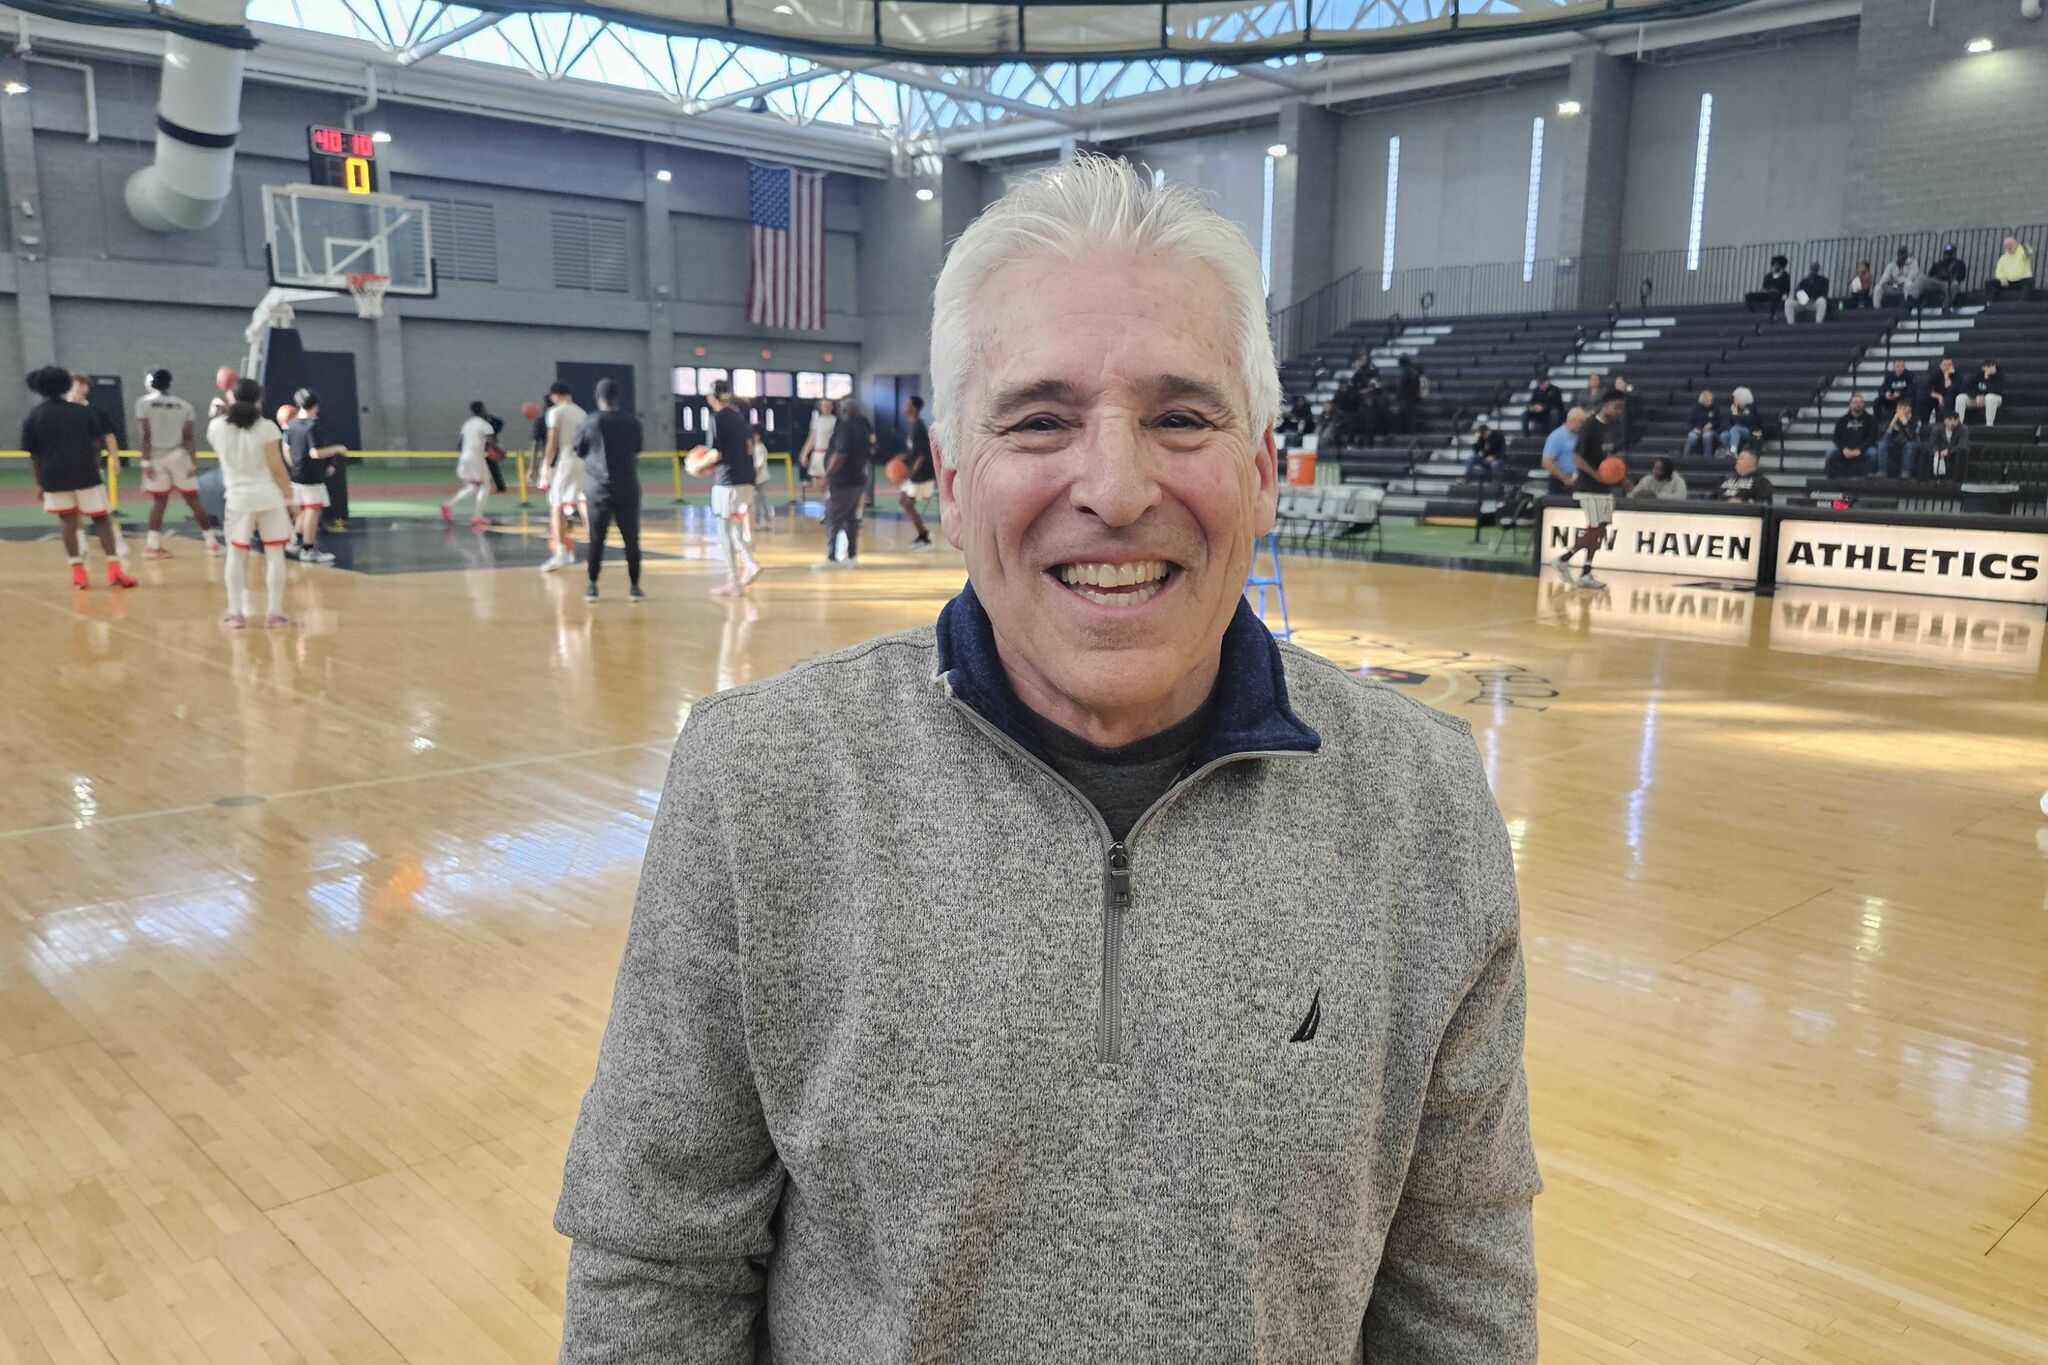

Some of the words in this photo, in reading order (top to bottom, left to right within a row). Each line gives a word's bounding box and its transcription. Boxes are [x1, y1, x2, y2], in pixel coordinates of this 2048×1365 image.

[315, 130, 343, 153] 40
[352, 133, 373, 156] 10
[346, 156, 370, 194] 0
[1636, 531, 1751, 561] HAVEN
[1786, 541, 2040, 581] ATHLETICS
